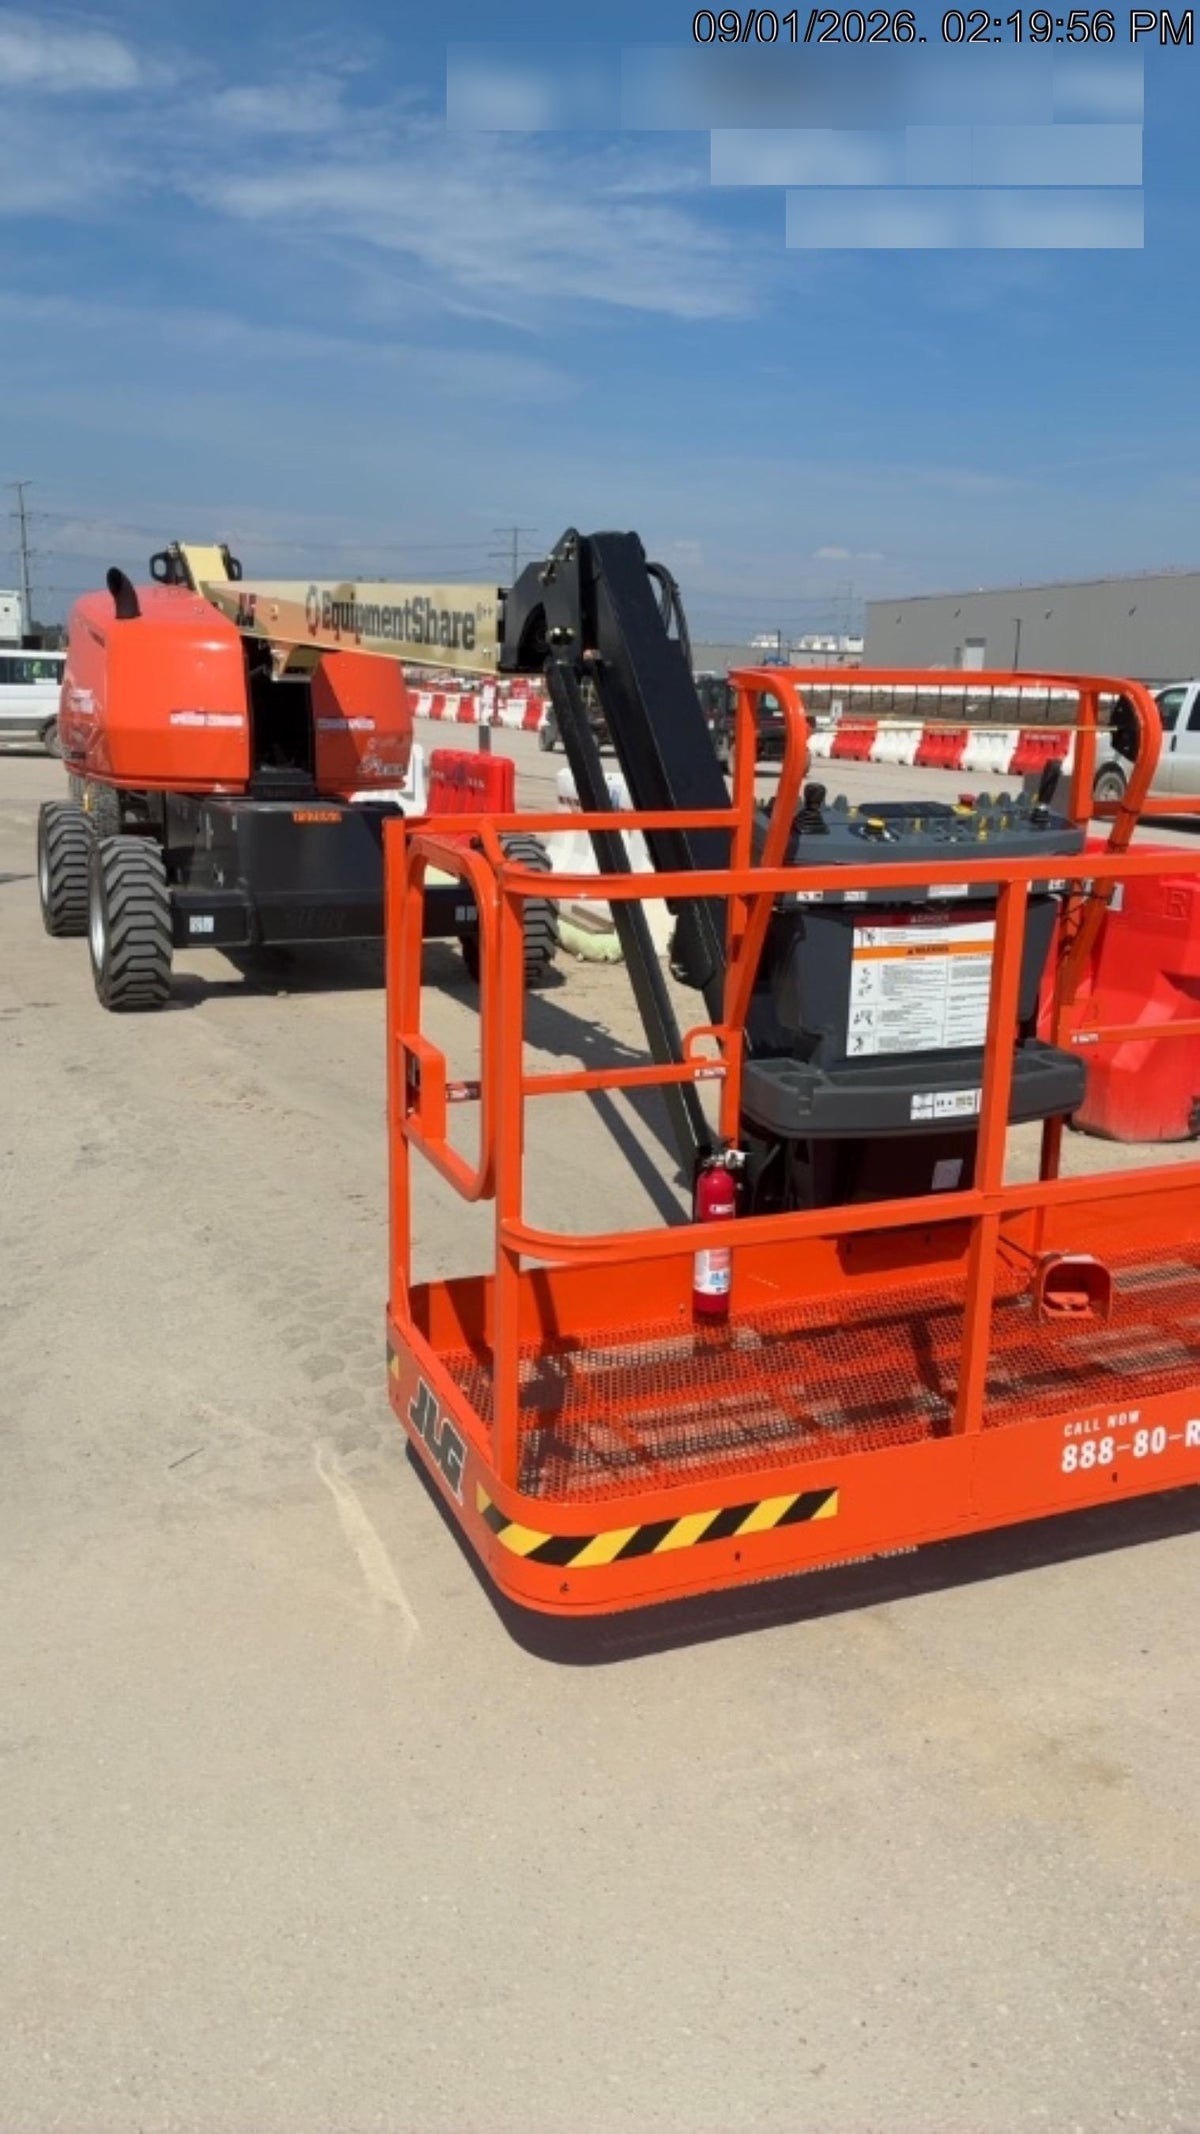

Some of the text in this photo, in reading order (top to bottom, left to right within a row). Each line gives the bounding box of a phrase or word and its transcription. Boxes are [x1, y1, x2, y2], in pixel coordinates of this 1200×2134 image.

[322, 589, 476, 650] EquipmentShare
[408, 1375, 468, 1505] JLG
[1064, 1410, 1140, 1438] CALL NOW
